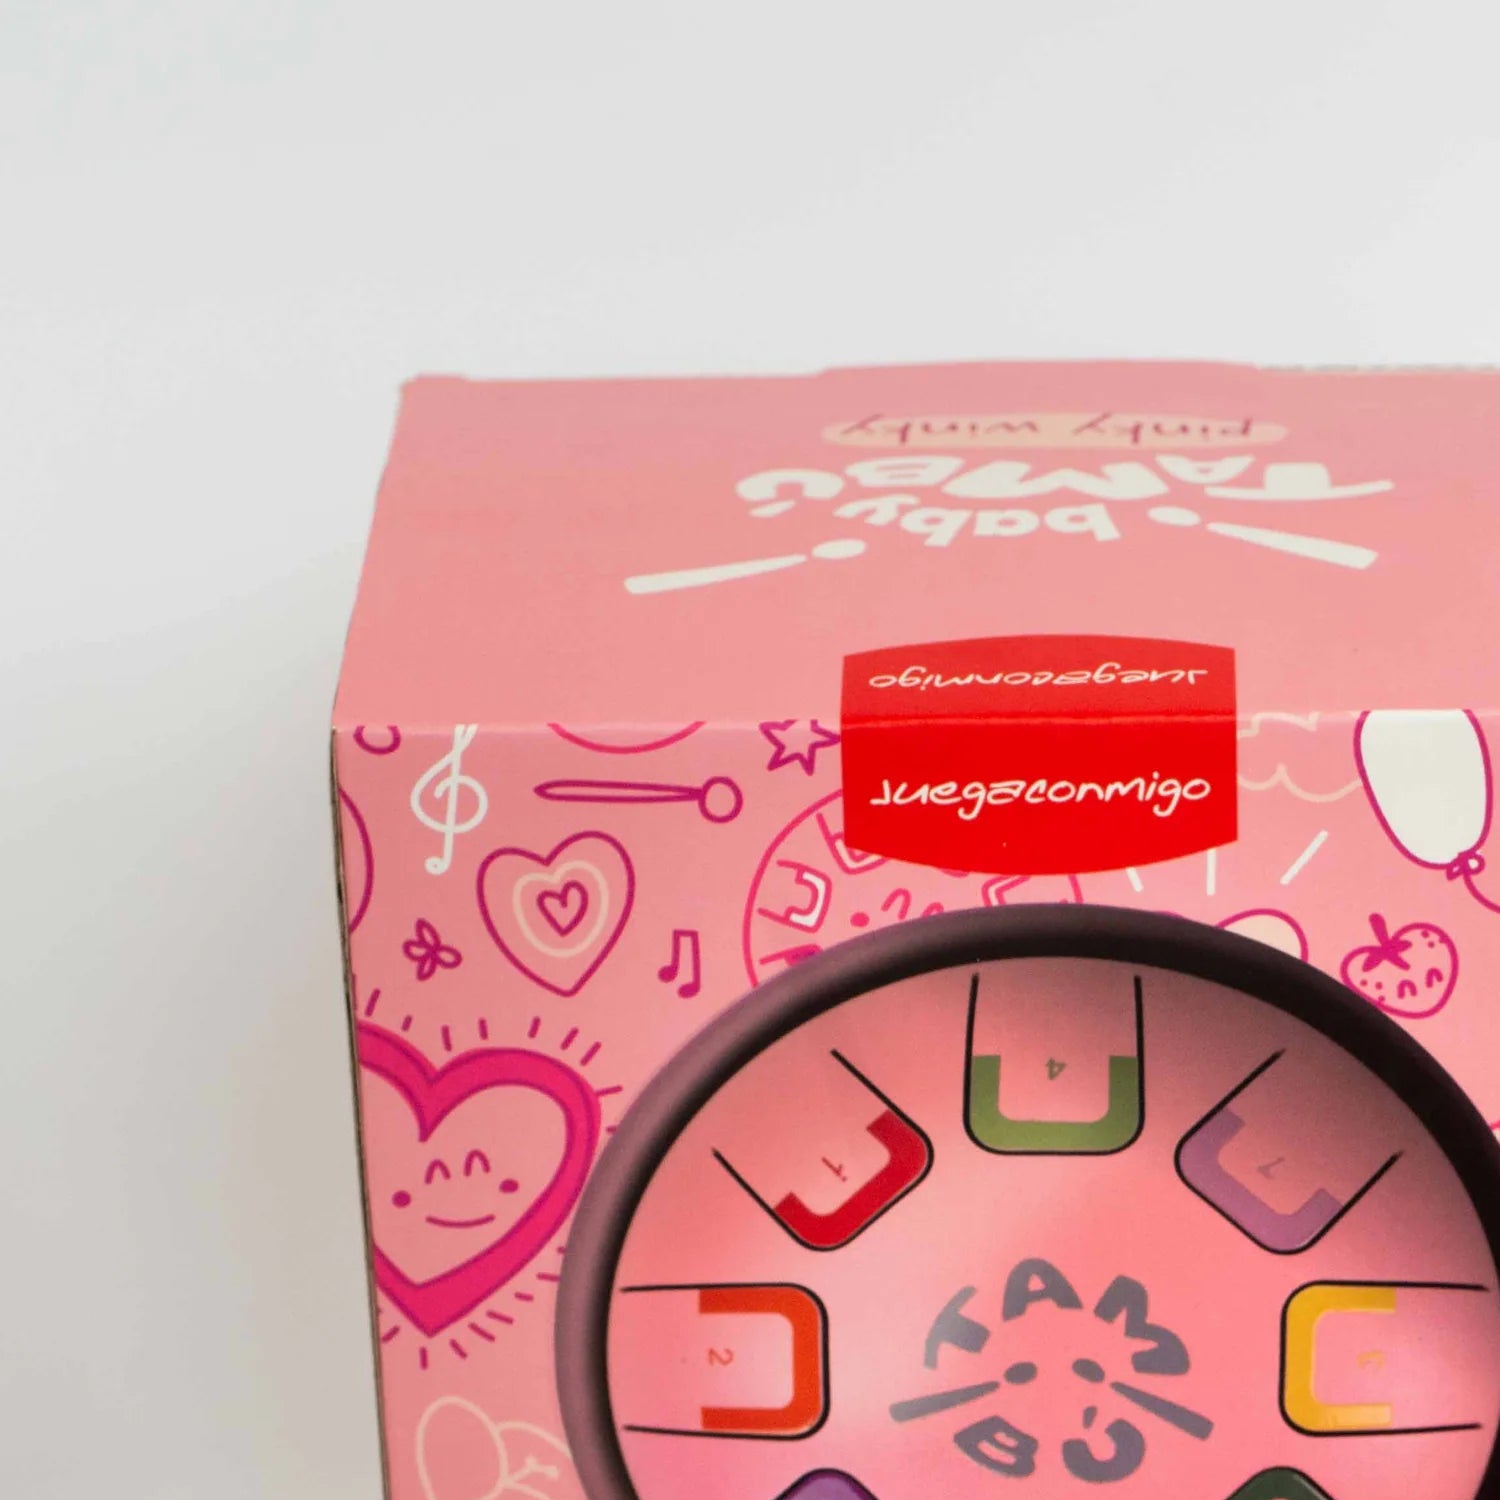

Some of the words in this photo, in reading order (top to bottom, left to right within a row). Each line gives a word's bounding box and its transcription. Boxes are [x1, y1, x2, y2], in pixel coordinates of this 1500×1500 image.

[839, 411, 1043, 446] winky
[1070, 410, 1255, 446] pinky
[832, 493, 1122, 548] baby
[1044, 1056, 1068, 1081] 4
[706, 1346, 734, 1367] 2
